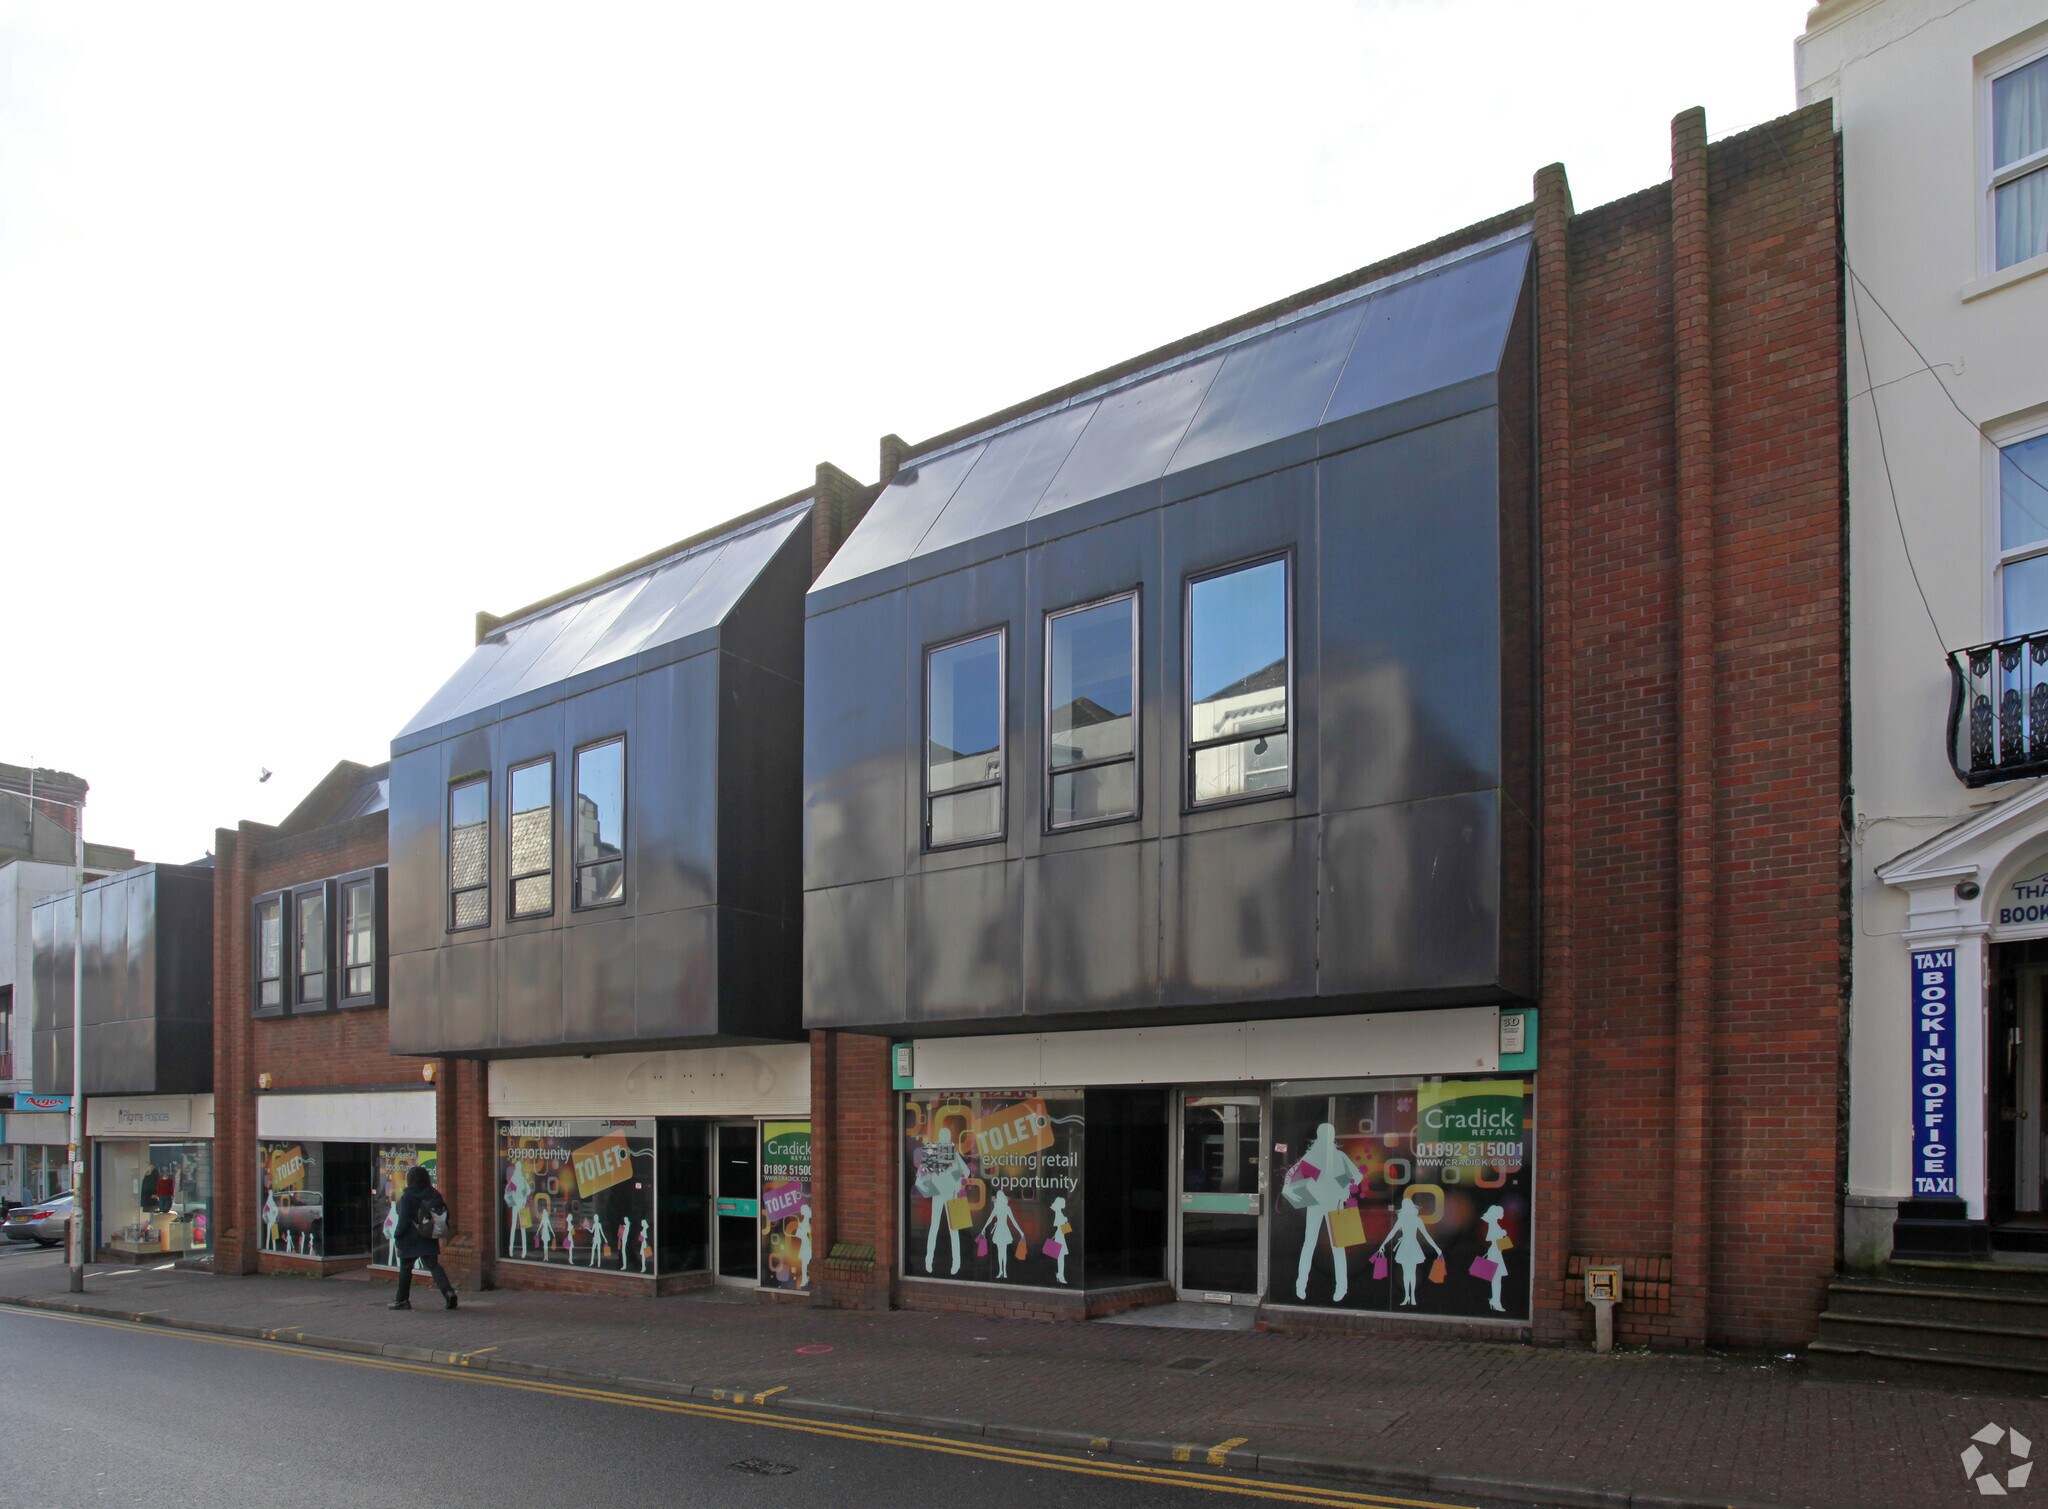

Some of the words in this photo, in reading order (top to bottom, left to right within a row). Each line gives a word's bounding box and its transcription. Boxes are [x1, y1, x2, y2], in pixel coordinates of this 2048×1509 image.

[1914, 951, 1952, 970] TAXI
[1921, 971, 1947, 1077] BOOKING
[25, 1097, 64, 1107] Argos
[123, 1110, 143, 1125] Pilgrims
[145, 1111, 169, 1124] Hospices
[1425, 1107, 1515, 1129] Cradick
[501, 1124, 541, 1140] exciting
[543, 1123, 571, 1138] retail
[1922, 1083, 1947, 1173] OFFICE
[507, 1146, 571, 1164] opportunity
[768, 1141, 811, 1155] Cradick
[1416, 1142, 1463, 1158] 01892
[1468, 1142, 1523, 1157] 515001
[982, 1152, 1037, 1170] exciting
[1041, 1151, 1078, 1167] retail
[1416, 1158, 1523, 1167] WWW.CRADICK.CO.UK
[763, 1164, 787, 1175] 01892
[991, 1174, 1078, 1193] opportunity
[1915, 1177, 1954, 1193] TAXI
